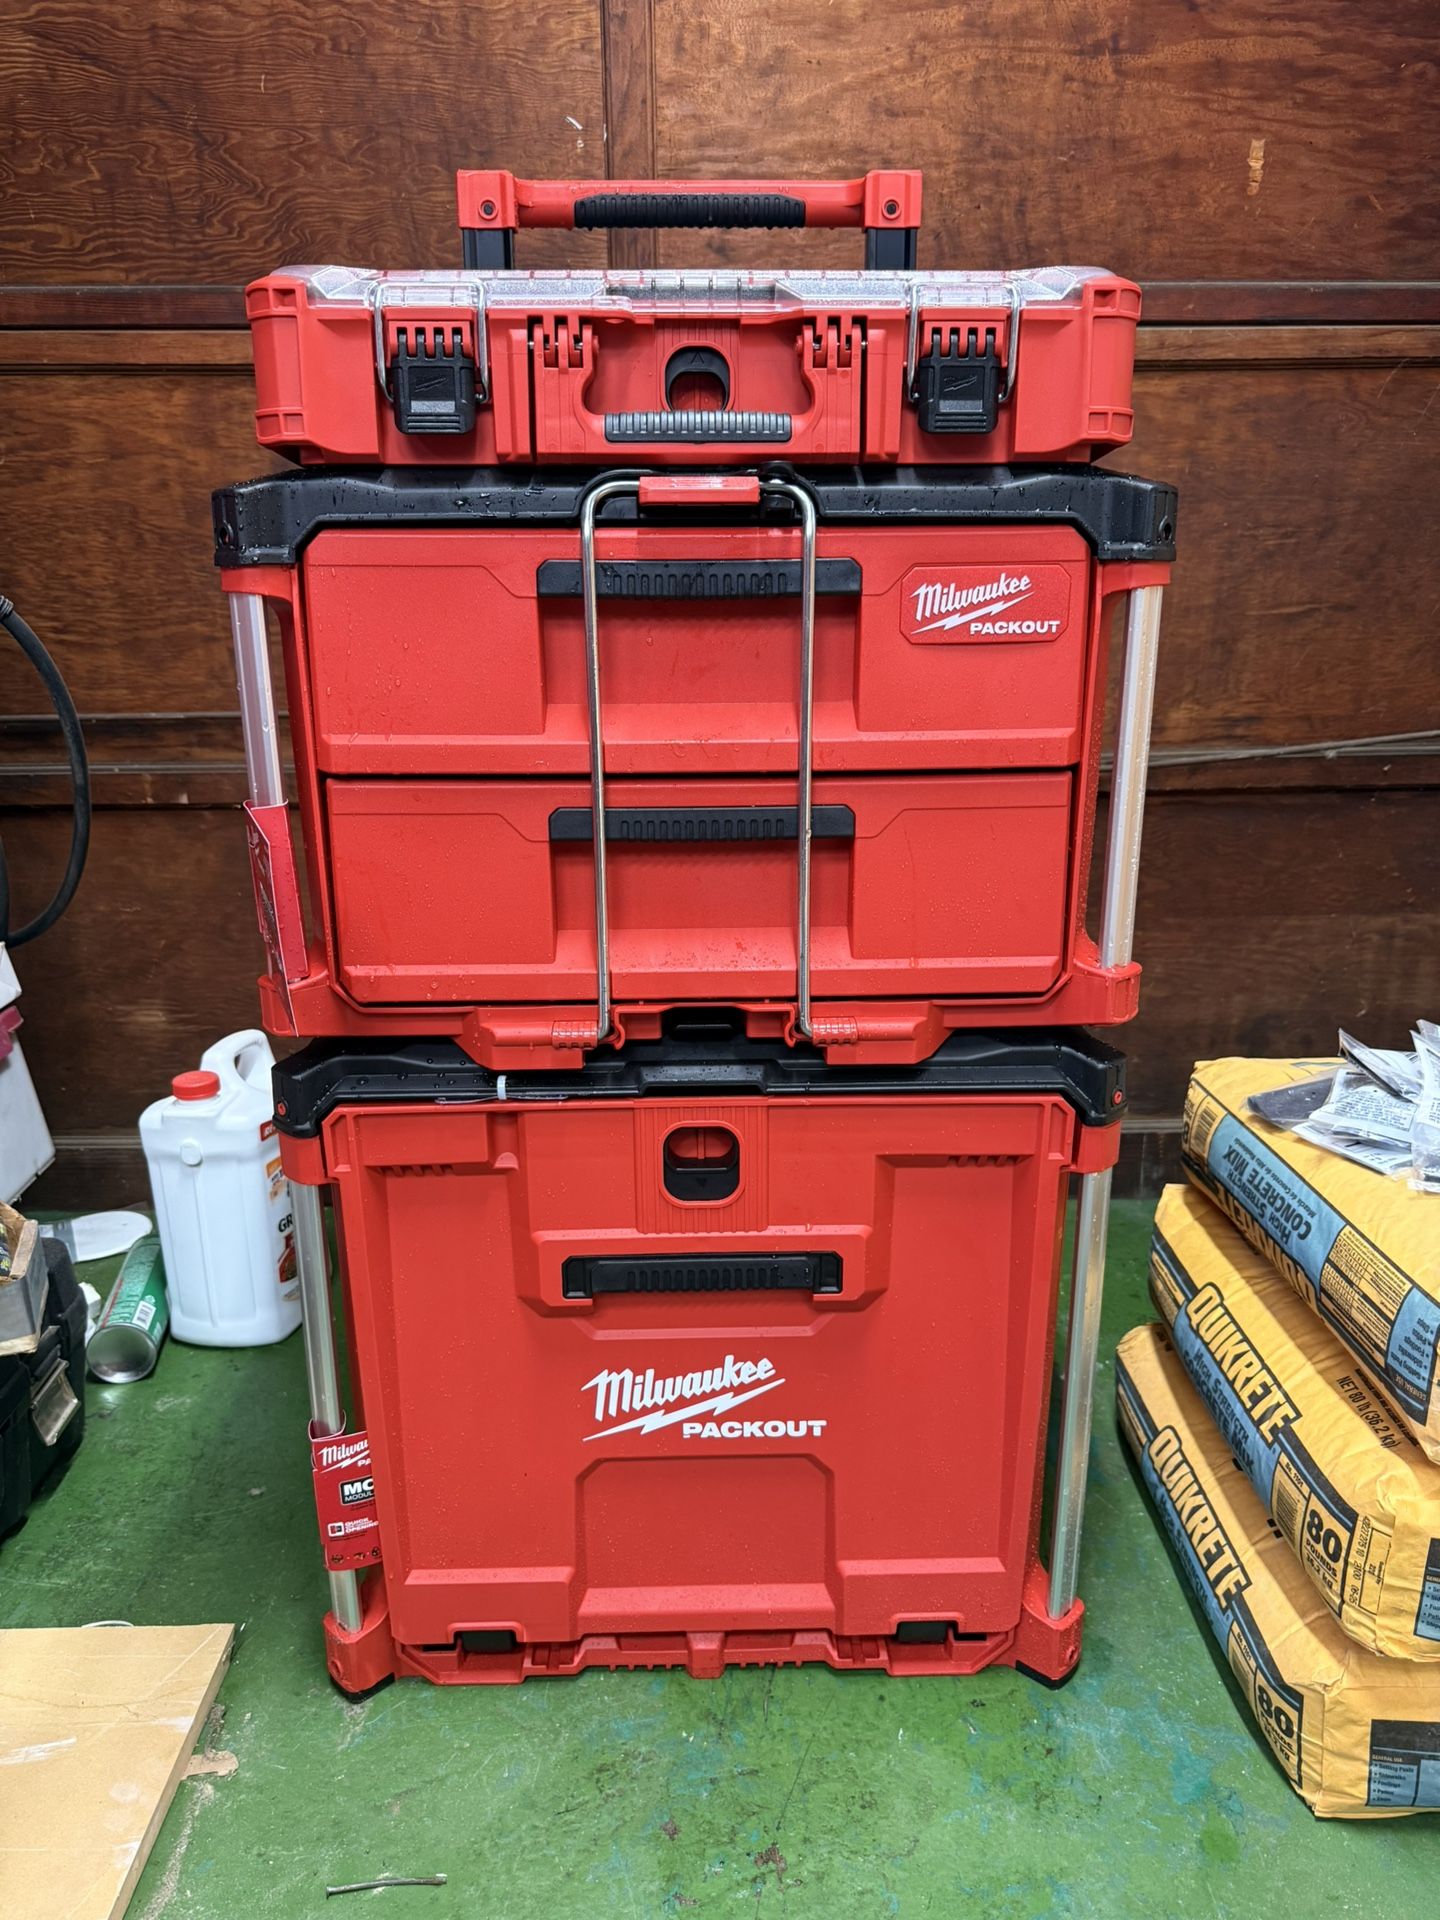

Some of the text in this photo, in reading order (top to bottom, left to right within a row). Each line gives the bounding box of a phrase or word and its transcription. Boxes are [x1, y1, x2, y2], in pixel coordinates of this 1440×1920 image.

[910, 572, 1032, 621] Milwaukee
[970, 620, 1061, 634] PACKOUT
[1221, 1145, 1313, 1241] CONCRETE MIX
[1224, 1168, 1292, 1243] HIGH STRENGTH
[581, 1355, 775, 1421] Milwaukee
[1185, 1284, 1297, 1444] QUIKRETE
[1336, 1374, 1359, 1394] NET
[1210, 1377, 1251, 1444] STRENGTH
[1349, 1390, 1365, 1404] 80
[1356, 1400, 1371, 1412] lb
[1360, 1410, 1391, 1434] (36.2
[683, 1420, 827, 1438] PACKOUT
[1149, 1431, 1247, 1606] QUIKRETE
[1306, 1509, 1342, 1563] 80
[1305, 1538, 1338, 1577] POUNDS
[1259, 1685, 1294, 1739] 80
